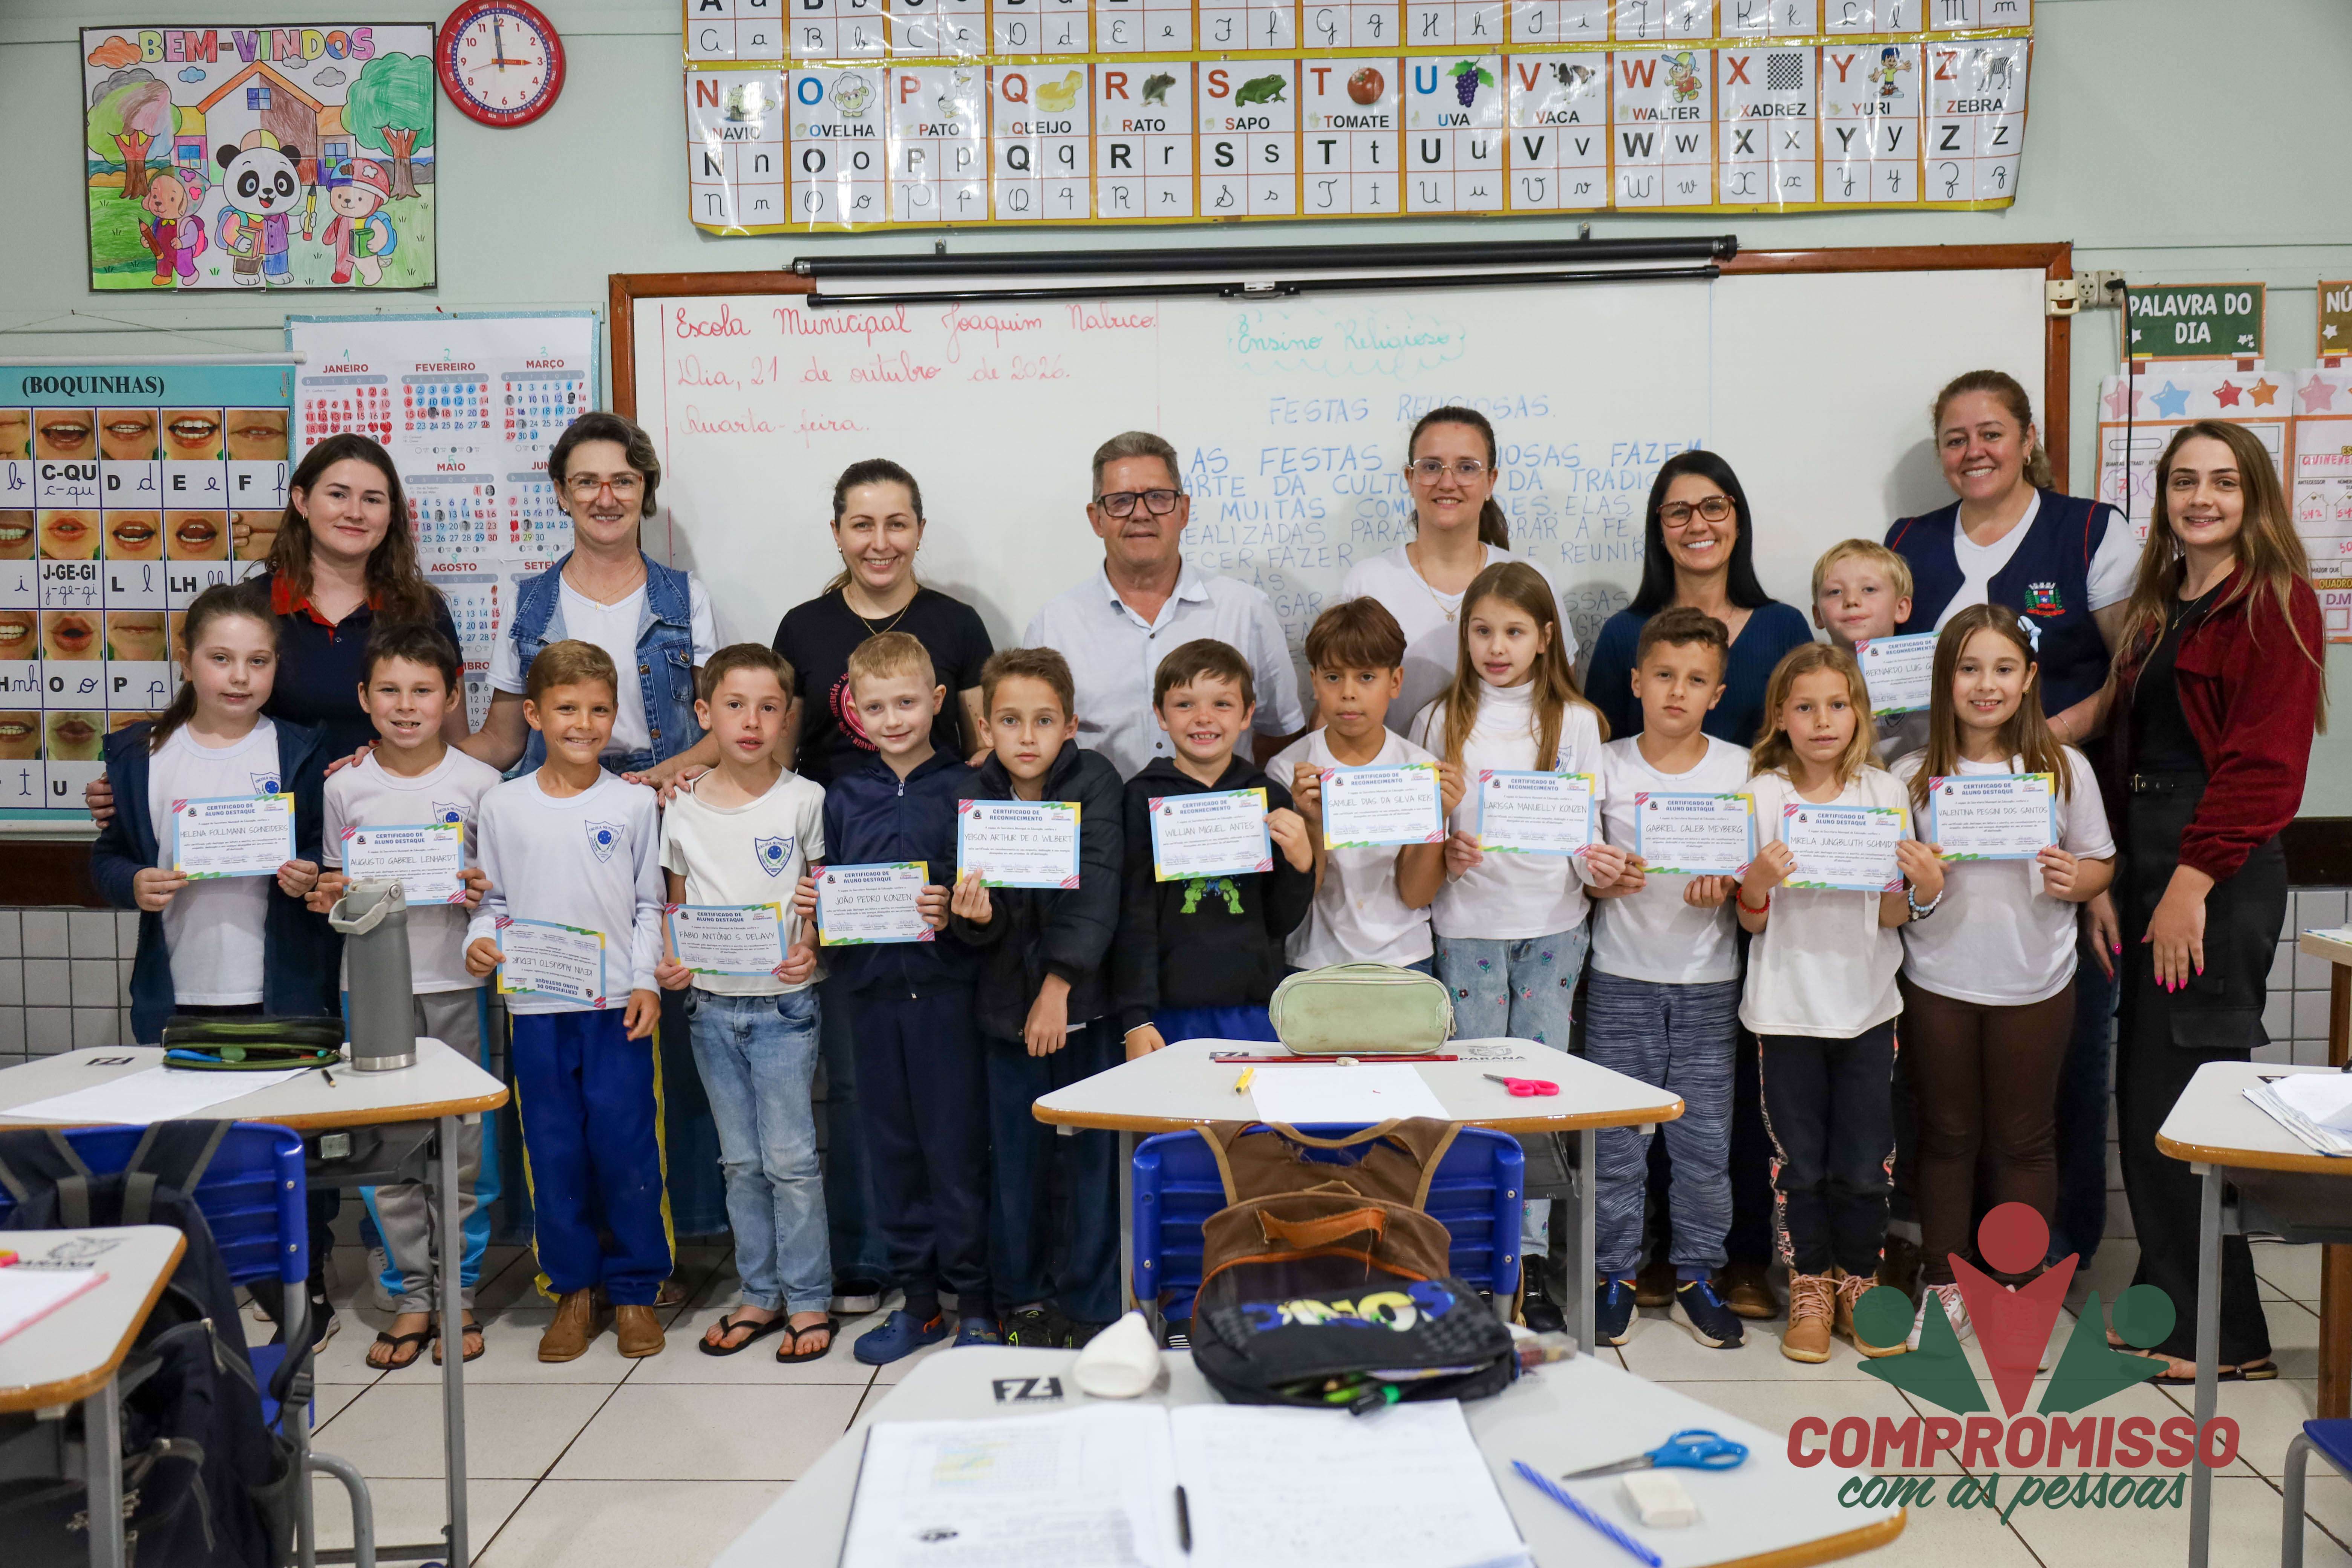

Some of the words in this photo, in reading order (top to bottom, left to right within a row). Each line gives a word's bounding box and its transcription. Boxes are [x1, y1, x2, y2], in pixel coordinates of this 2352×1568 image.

[478, 24, 486, 32] 11
[138, 28, 375, 63] BEM-VINDOS
[466, 38, 476, 46] 10
[461, 58, 466, 66] 9
[468, 77, 473, 86] 8
[532, 77, 539, 85] 4
[502, 97, 507, 105] 6
[521, 91, 526, 100] 5
[1740, 103, 1807, 116] XADREZ
[1852, 103, 1891, 116] YURI
[1947, 99, 2003, 113] ZEBRA
[1438, 113, 1470, 126] UVA
[1536, 111, 1580, 124] VACA
[1633, 107, 1700, 120] WALTER
[1011, 121, 1072, 135] QUEIJO
[1122, 119, 1166, 132] RATO
[1225, 118, 1270, 130] SAPO
[1324, 115, 1389, 128] TOMATE
[712, 126, 761, 140] NAVIO
[809, 124, 875, 137] OVELHA
[919, 124, 960, 135] PATO
[2129, 294, 2217, 317] PALAVRA
[2225, 293, 2252, 315] DO
[675, 307, 751, 339] Escola
[773, 305, 912, 347] Municipal
[941, 303, 1043, 363] Joaquim
[2175, 322, 2211, 344] DIA
[1239, 314, 1323, 353] Ensino
[1335, 317, 1449, 369] Religioso
[444, 349, 451, 361] 2
[540, 346, 548, 357] 3
[323, 364, 369, 374] JANEIRO
[415, 362, 475, 372] FEVEREIRO
[526, 360, 564, 370] MARÇO
[677, 354, 741, 390] Dia,
[751, 357, 778, 384] 21
[799, 360, 833, 384] de
[850, 351, 941, 383] outubro
[967, 358, 1000, 382] de
[22, 376, 164, 397] (BOQUINHAS)
[1270, 397, 1369, 424] FESTAS
[1191, 447, 1228, 473] AS
[1260, 444, 1383, 476] FESTAS
[42, 464, 96, 481] C-QU
[107, 475, 120, 490] D
[137, 463, 155, 490] d
[173, 475, 186, 490] E
[204, 477, 220, 490] e
[239, 475, 252, 490] F
[272, 463, 286, 506] f
[1178, 473, 1245, 498] ARTE
[1274, 476, 1305, 497] DA
[1508, 469, 1542, 491] DA
[1221, 498, 1325, 522] MUITAS
[1179, 520, 1326, 545] EALIZADAS
[1351, 520, 1407, 542] PARA
[1576, 516, 1588, 538] A
[451, 553, 458, 563] 8
[1268, 543, 1353, 568] FAZER
[43, 565, 96, 580] J-GE-GI
[431, 564, 477, 572] AGOSTO
[112, 577, 124, 592] L
[170, 577, 196, 592] LH
[1866, 666, 1902, 677] BERNARDO
[49, 677, 64, 692] O
[77, 678, 98, 694] o
[114, 677, 127, 692] P
[147, 681, 165, 708] p
[1328, 799, 1357, 807] SAMUEL
[1394, 795, 1414, 803] SILVA
[1517, 803, 1556, 812] MANUELLY
[1559, 805, 1587, 813] KONZEN
[209, 827, 246, 836] FOLLMANN
[249, 825, 288, 833] SCHNEIDERS
[1199, 825, 1225, 833] MIGUEL
[1230, 821, 1254, 831] ANTES
[1791, 836, 1816, 845] MIRELA
[1820, 838, 1863, 847] JUNGBLUTH
[1867, 840, 1897, 848] SCHMIDT
[351, 858, 384, 866] AUGUSTO
[388, 856, 416, 864] GABRIEL
[421, 854, 458, 863] LENHARDT
[835, 896, 853, 905] JOÃO
[702, 932, 732, 940] ANTÔNIO
[540, 960, 571, 971] AUGUSTO
[574, 967, 593, 976] KEVIN
